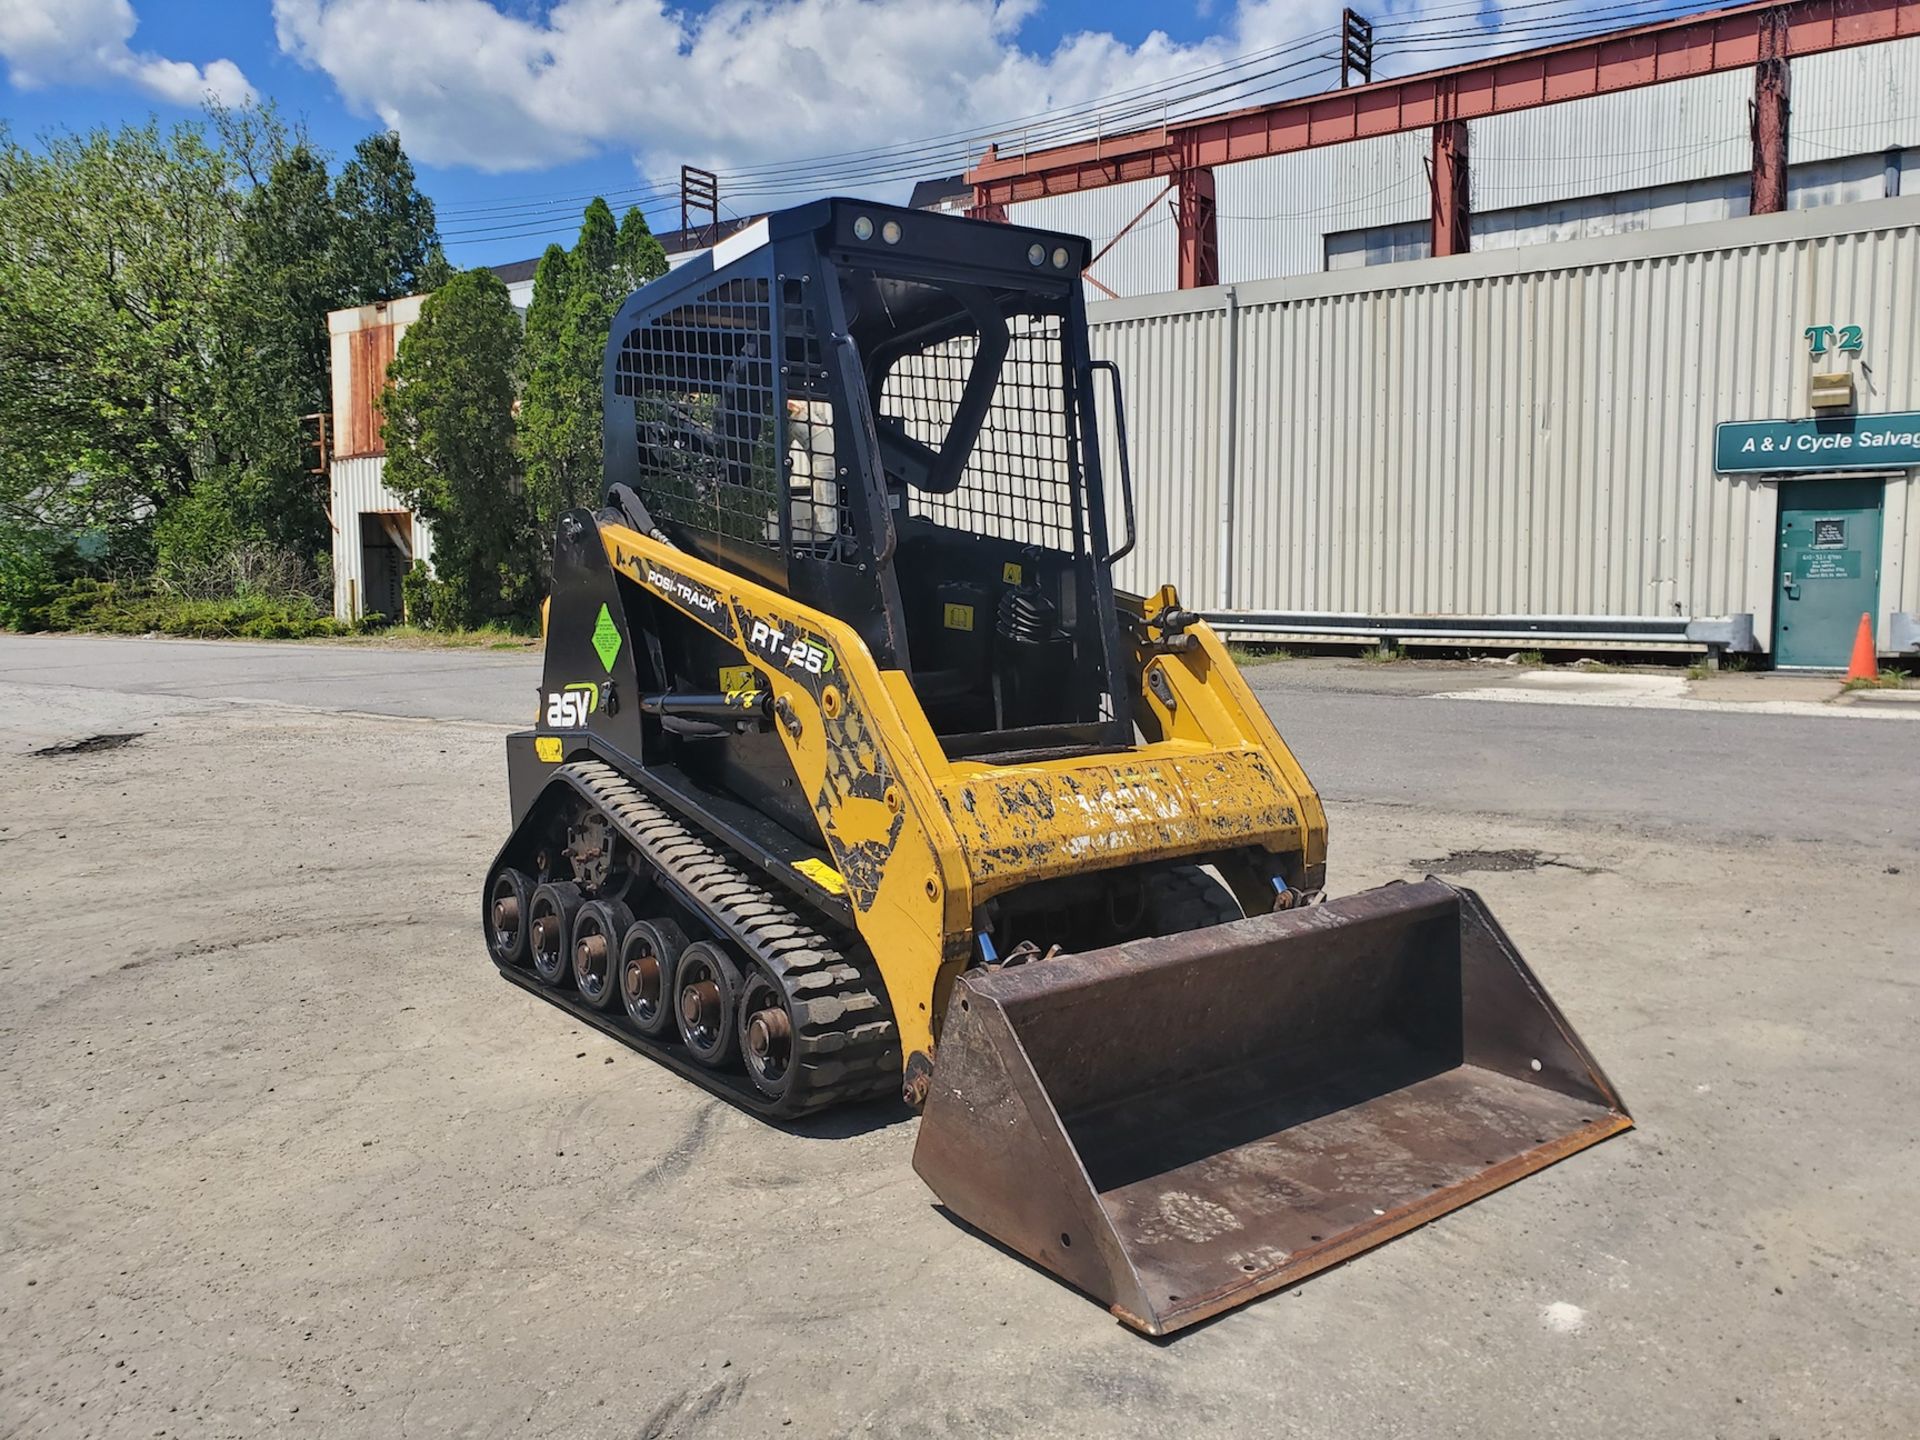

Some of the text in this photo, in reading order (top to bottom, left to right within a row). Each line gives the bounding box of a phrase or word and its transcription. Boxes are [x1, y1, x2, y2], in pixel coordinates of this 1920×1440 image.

[1741, 438, 1756, 453] A
[1760, 436, 1775, 452] &
[1779, 435, 1792, 451] J
[1797, 433, 1853, 453] Cycle
[647, 569, 717, 613] POSI-TRACK
[750, 620, 824, 674] RT-25
